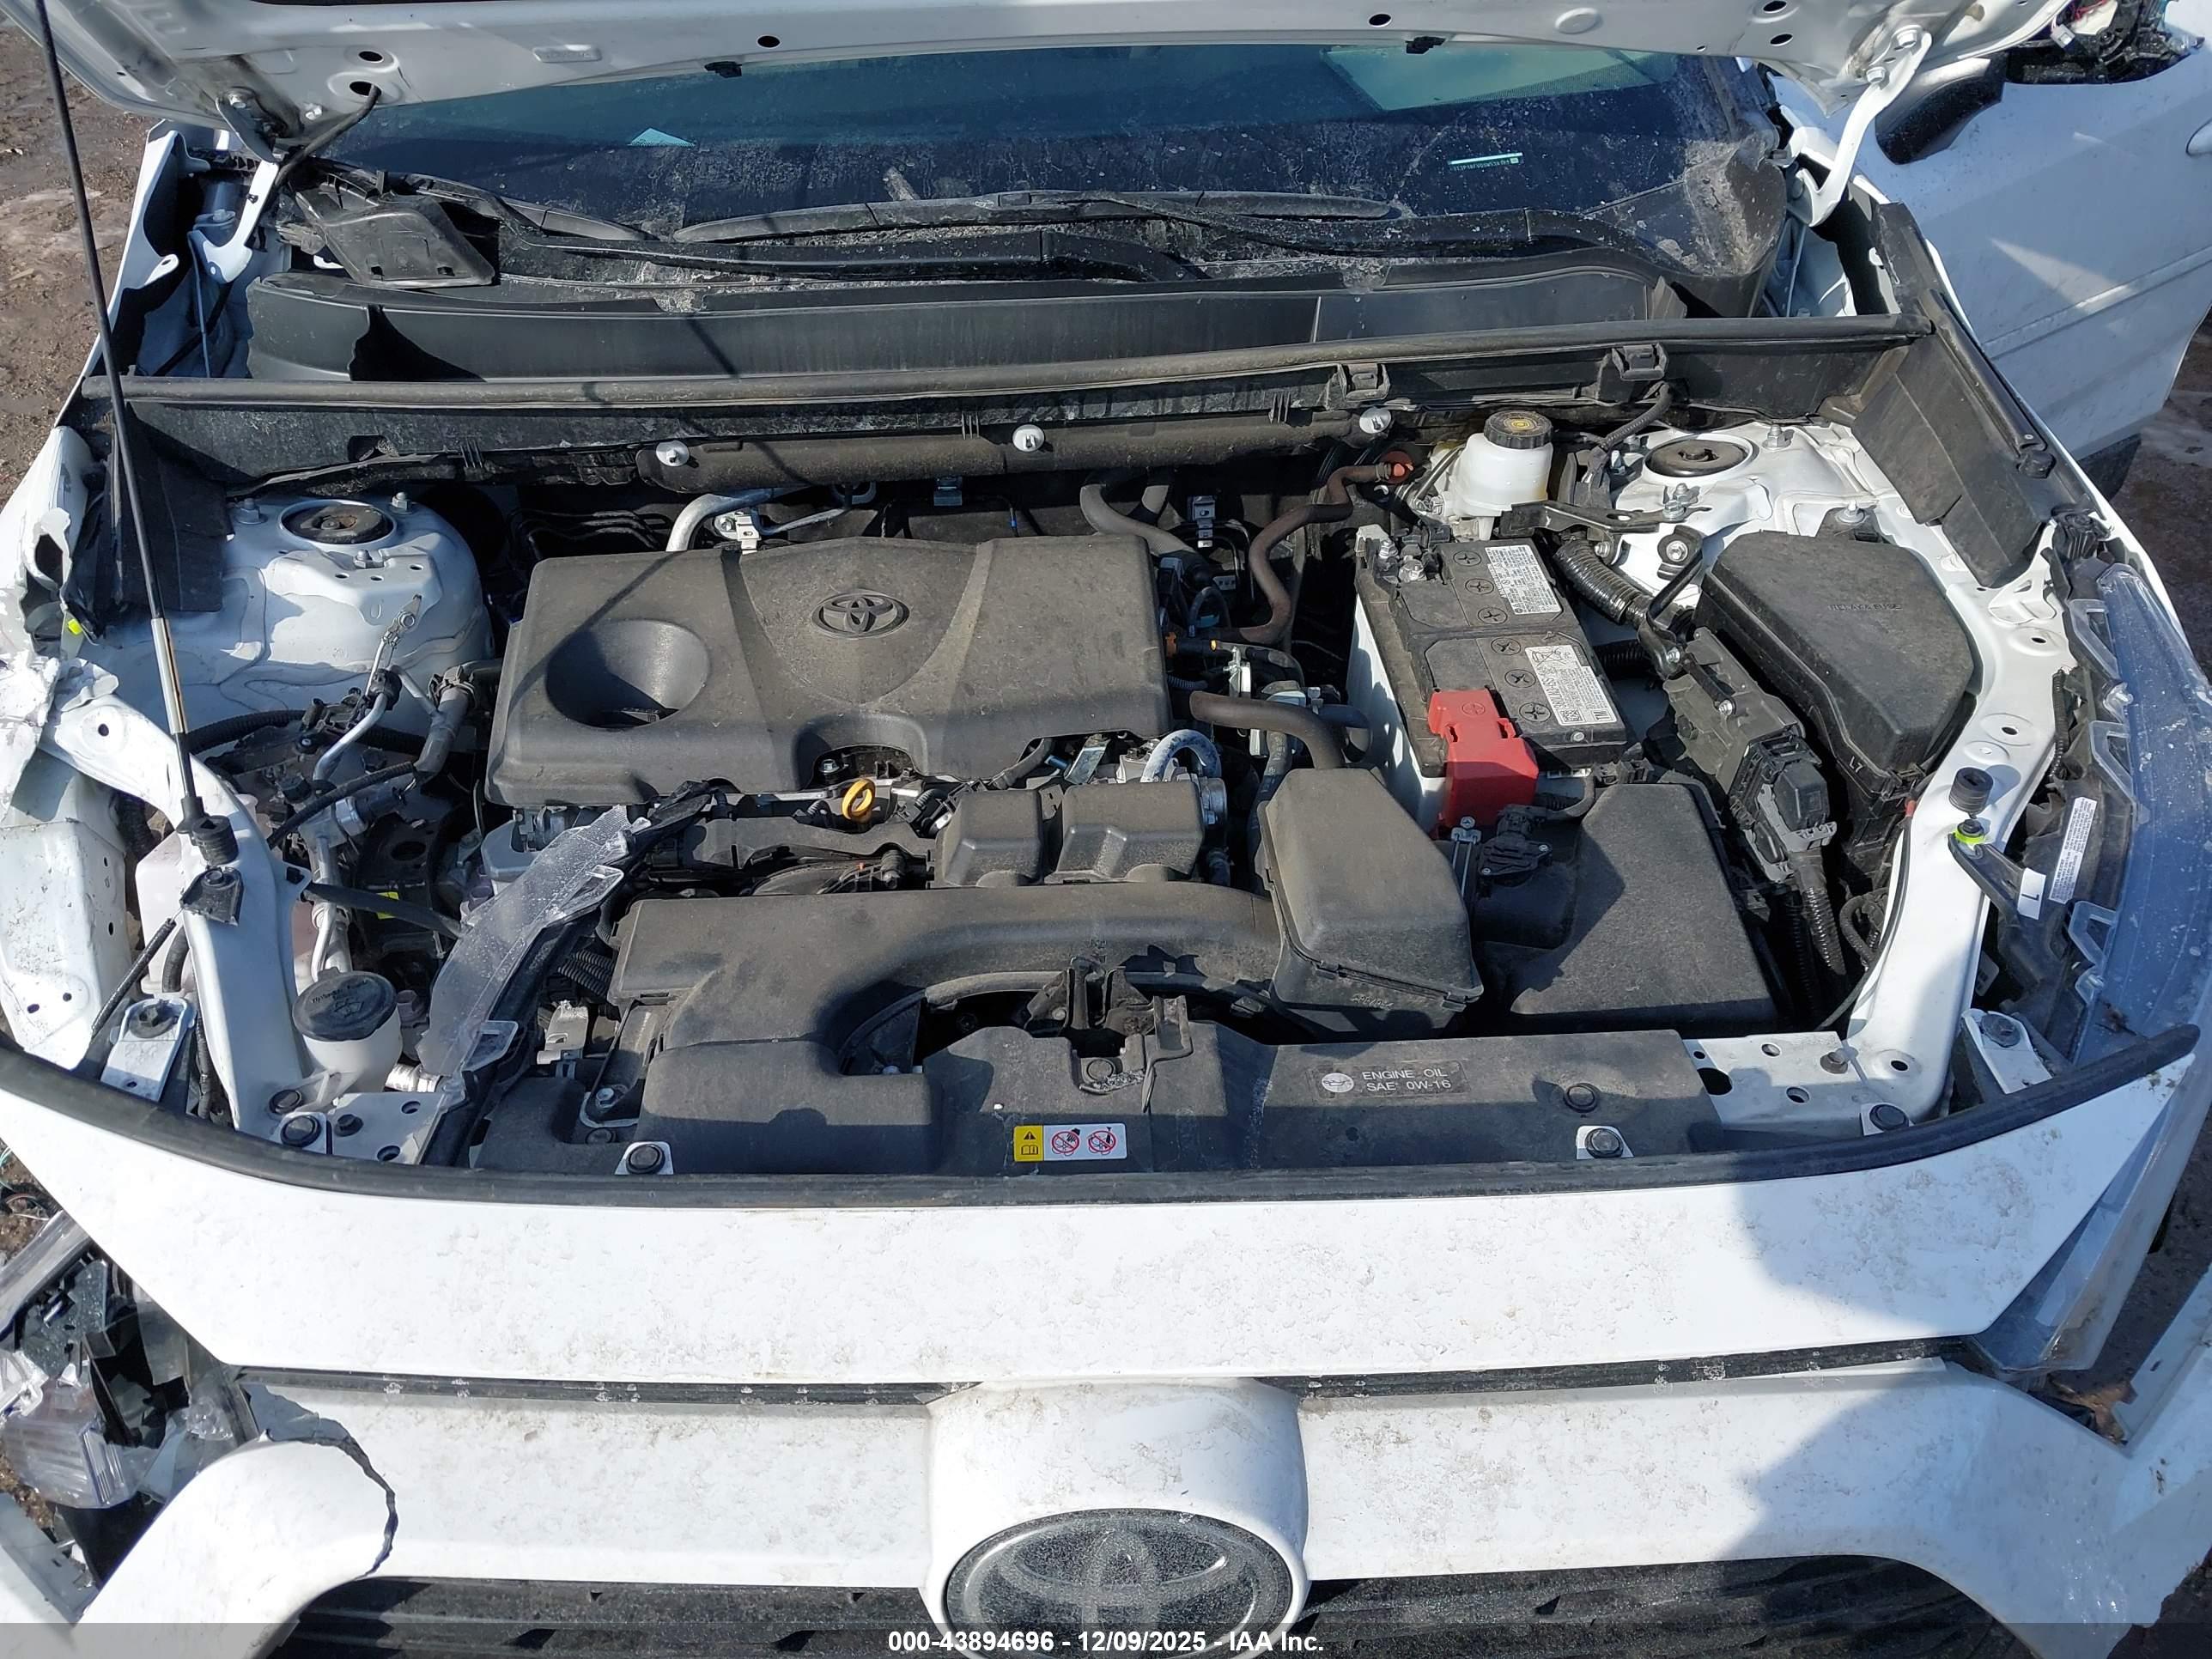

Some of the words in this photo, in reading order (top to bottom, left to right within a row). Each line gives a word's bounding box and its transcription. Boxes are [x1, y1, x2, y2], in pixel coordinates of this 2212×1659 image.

[1849, 756, 1863, 773] L7
[1362, 1070, 1415, 1080] ENGINE
[1424, 1068, 1448, 1078] OIL
[1366, 1081, 1397, 1091] SAE
[1407, 1079, 1451, 1091] 0W-16
